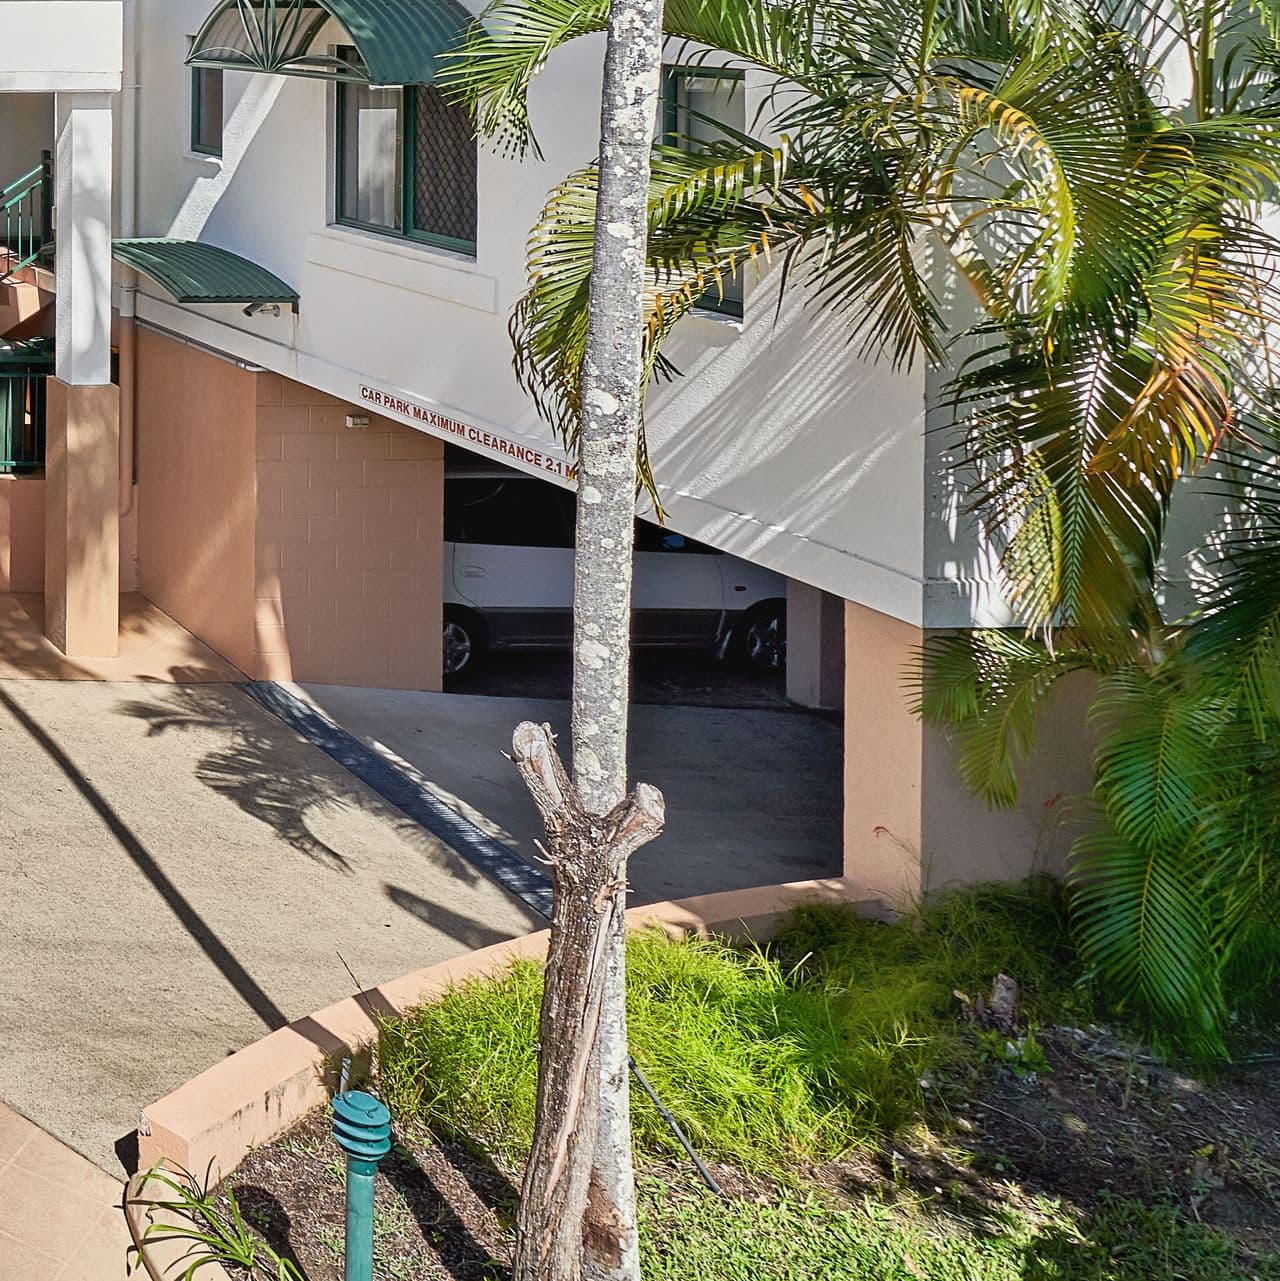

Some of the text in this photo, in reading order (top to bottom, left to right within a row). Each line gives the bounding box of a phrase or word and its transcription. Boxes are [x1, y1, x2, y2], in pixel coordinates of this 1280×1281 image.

[361, 387, 382, 404] CAR
[383, 395, 411, 416] PARK
[413, 406, 466, 437] MAXIMUM
[468, 428, 542, 467] CLEARANCE
[545, 458, 562, 474] 2.1
